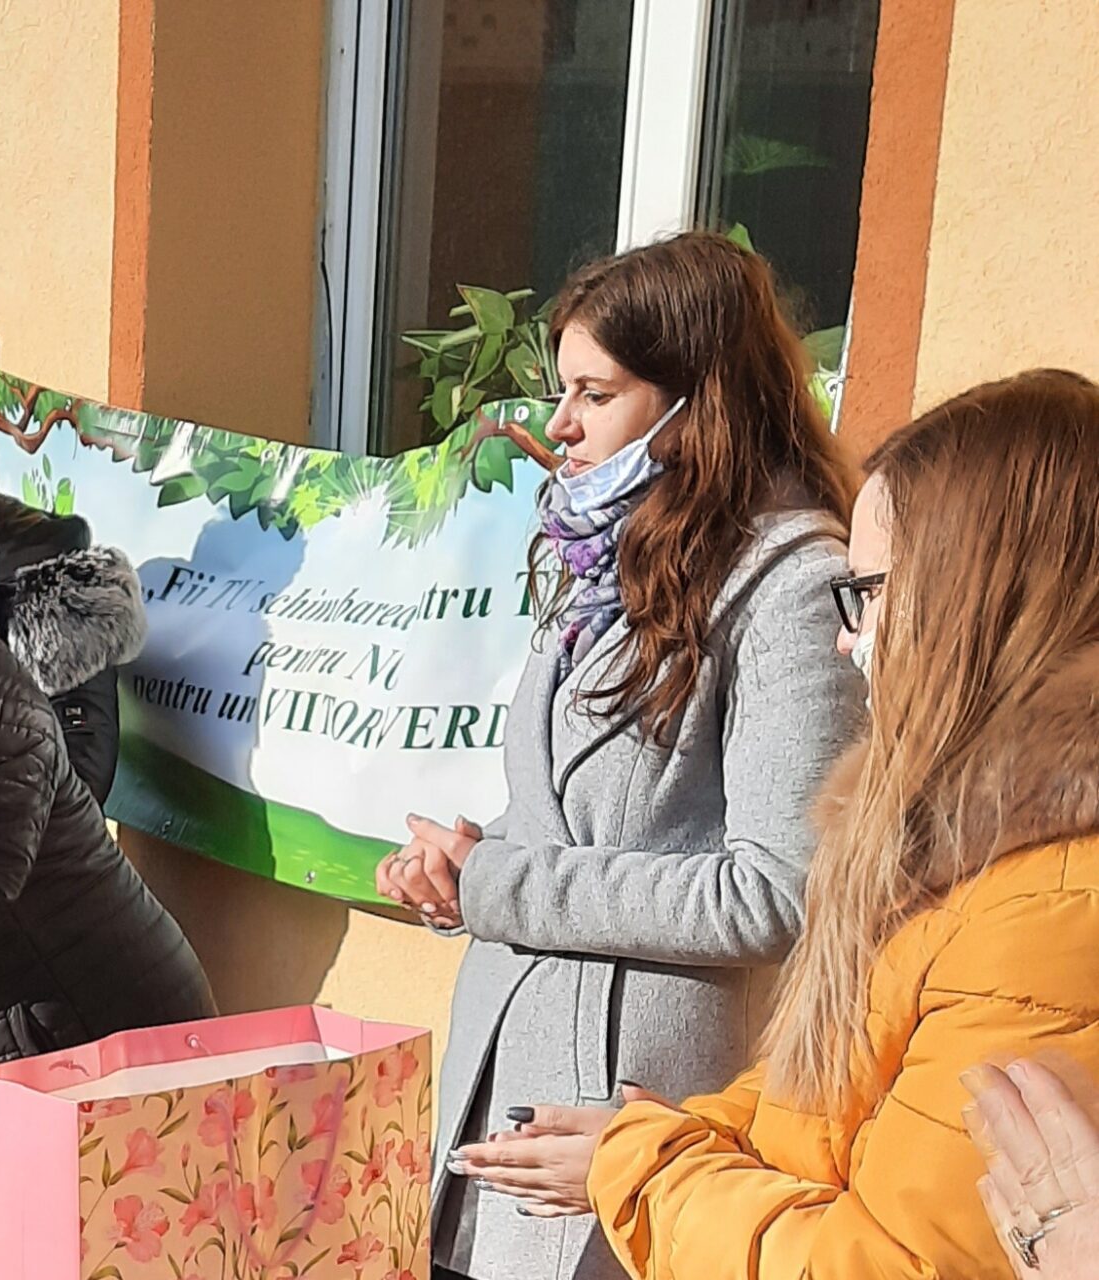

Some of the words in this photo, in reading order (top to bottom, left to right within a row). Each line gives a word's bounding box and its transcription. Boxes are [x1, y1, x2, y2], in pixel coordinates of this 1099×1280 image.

[205, 578, 265, 612] TU
[416, 581, 492, 621] tru
[241, 640, 348, 677] pentru
[217, 692, 257, 724] un
